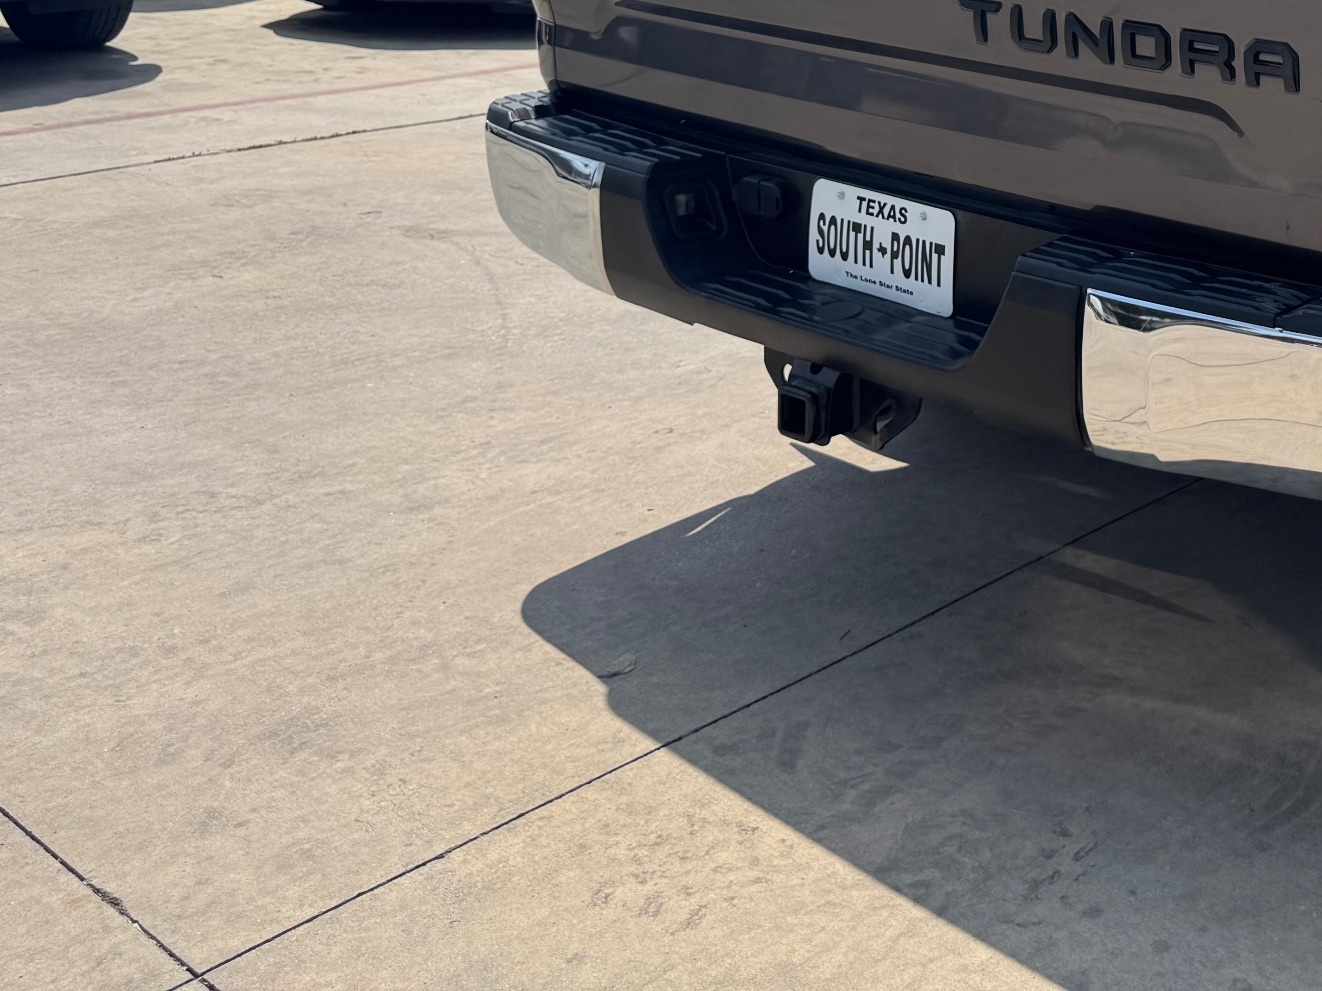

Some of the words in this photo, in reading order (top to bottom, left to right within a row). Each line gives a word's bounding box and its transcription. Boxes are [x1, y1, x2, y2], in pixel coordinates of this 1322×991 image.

[856, 195, 908, 225] TEXAS
[815, 212, 874, 269] SOUTH
[890, 231, 946, 288] POINT
[845, 271, 859, 280] The
[860, 275, 877, 285] Lone
[878, 280, 894, 290] Star
[895, 285, 914, 296] State
